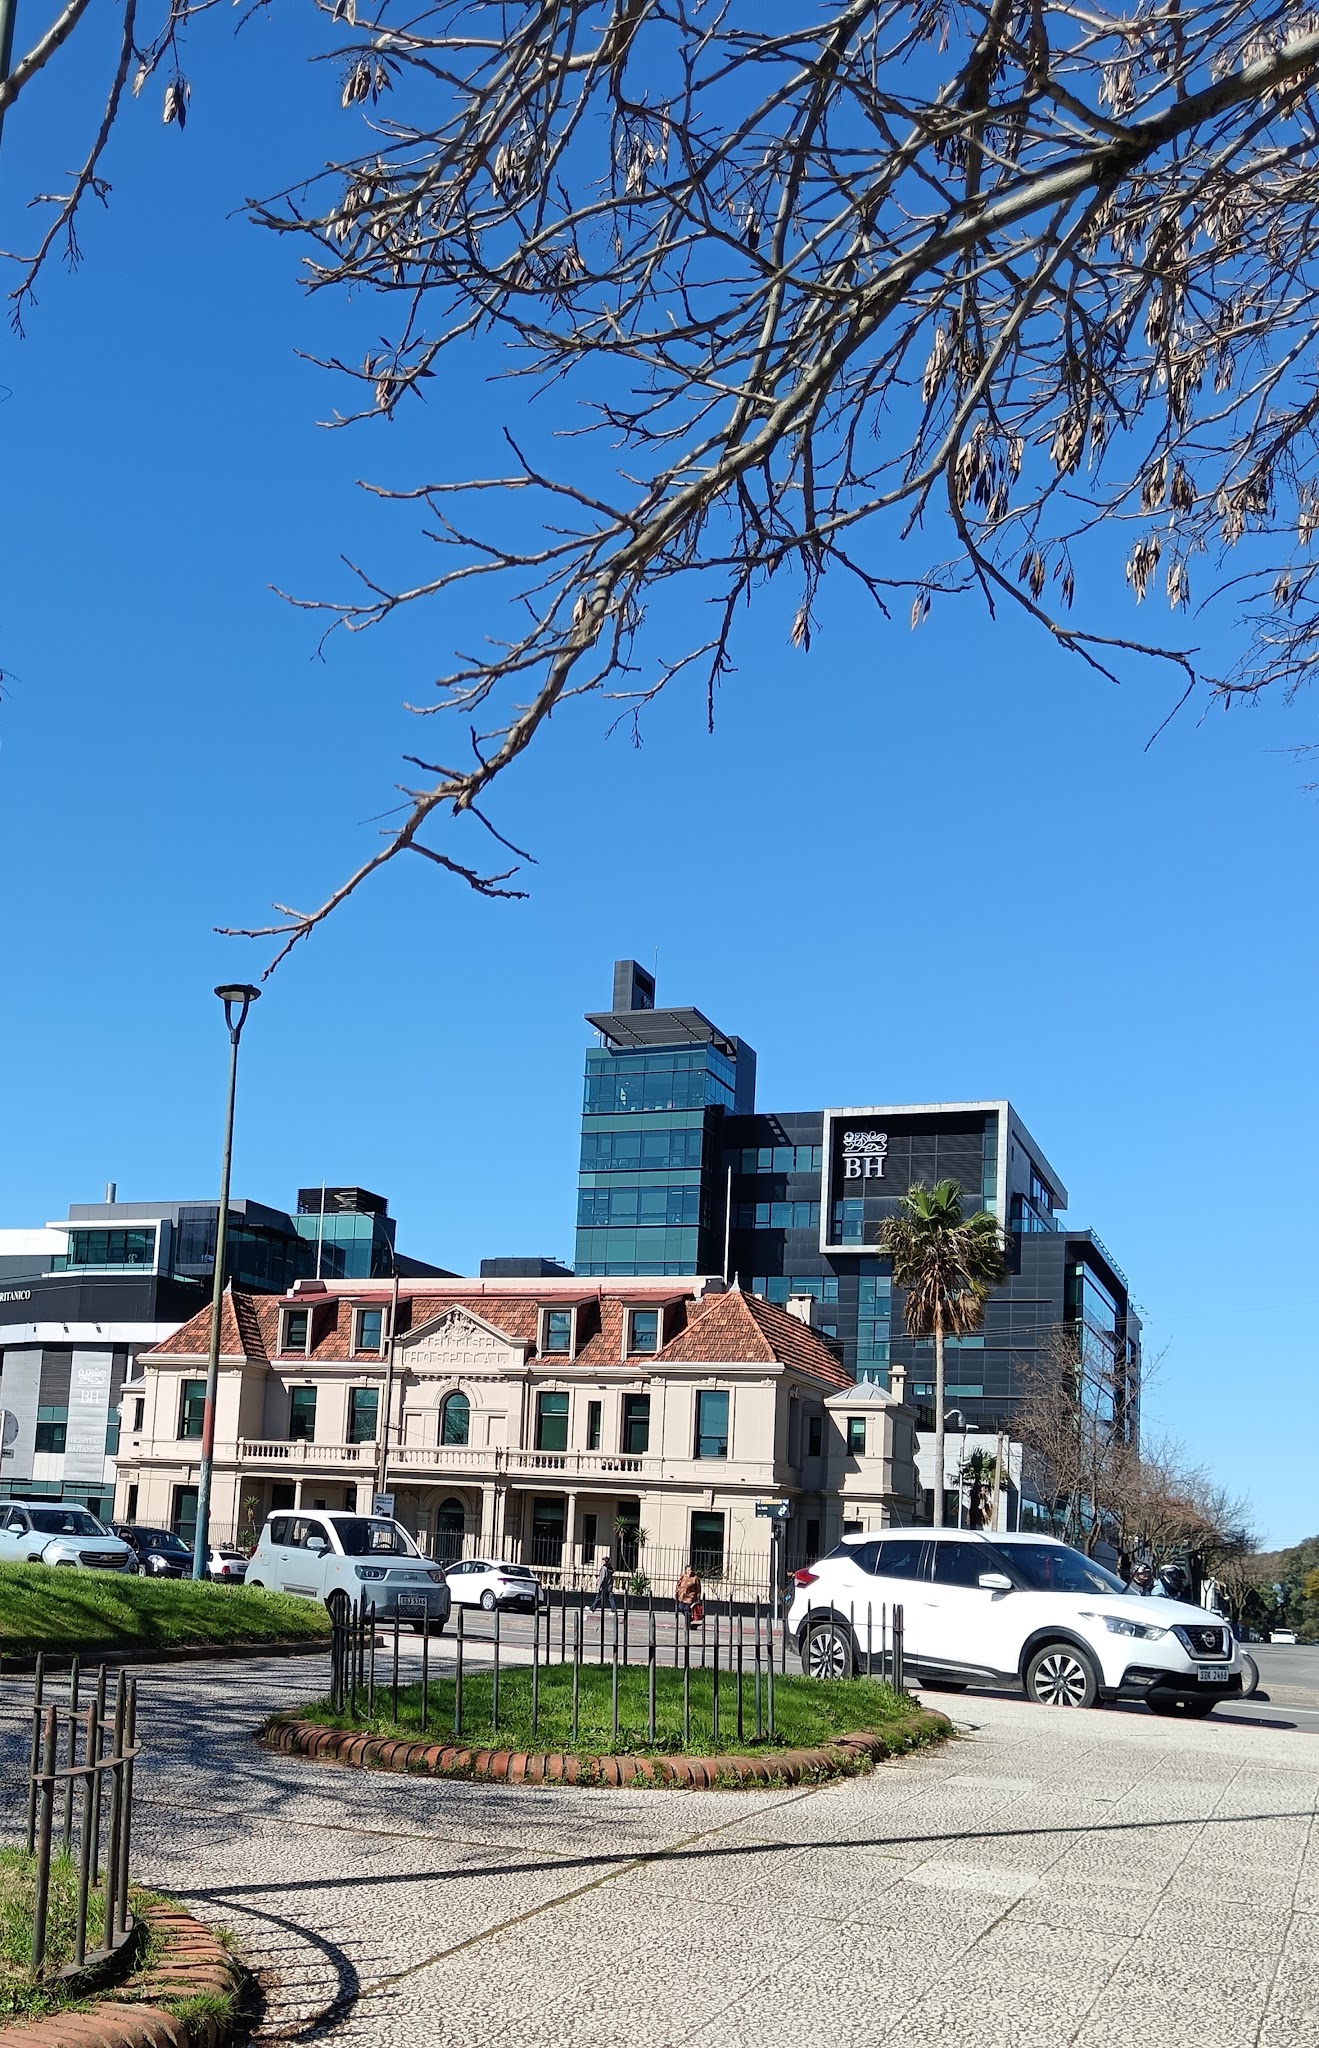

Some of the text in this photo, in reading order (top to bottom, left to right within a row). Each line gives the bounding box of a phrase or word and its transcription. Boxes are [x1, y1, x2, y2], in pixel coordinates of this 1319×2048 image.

[843, 1157, 885, 1178] BH
[421, 1337, 495, 1347] BRITISH
[404, 1351, 510, 1364] HOSPITAL
[81, 1390, 100, 1403] BH
[70, 1436, 100, 1444] HOSPITAL
